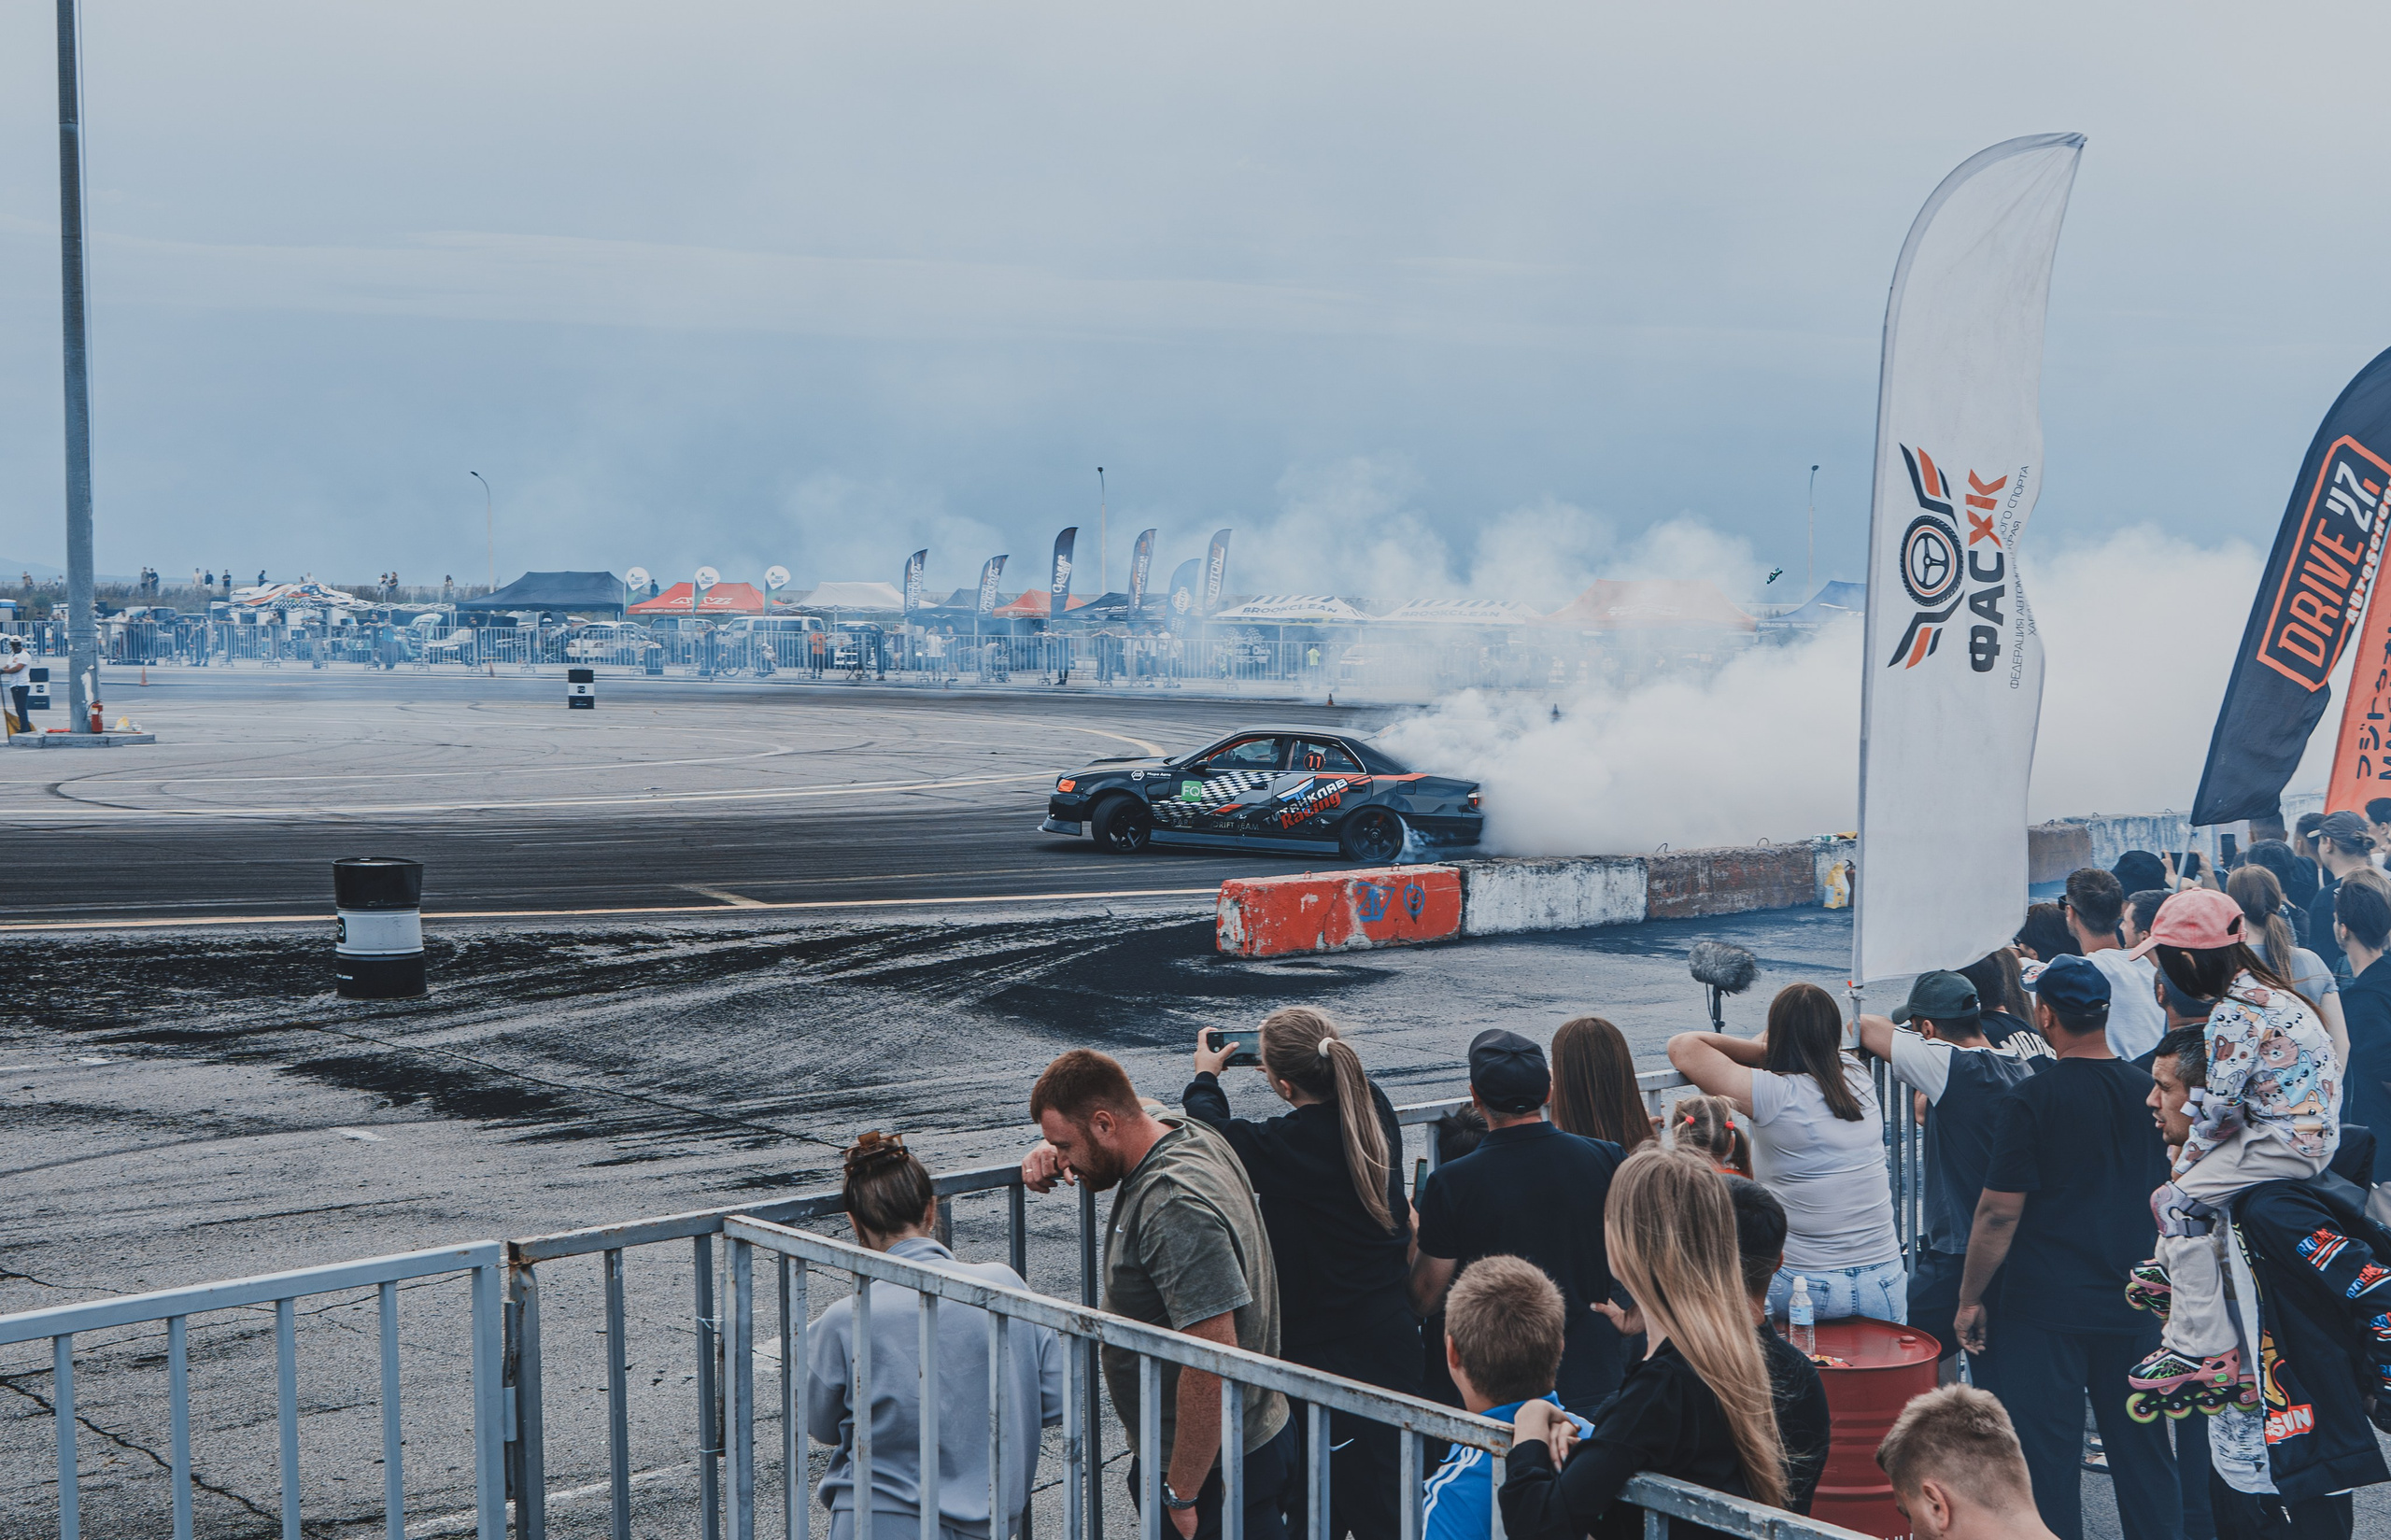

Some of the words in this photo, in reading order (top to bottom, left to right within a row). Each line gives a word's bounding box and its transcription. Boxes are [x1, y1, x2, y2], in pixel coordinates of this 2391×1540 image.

[2007, 465, 2030, 509] СПОРТА
[2344, 476, 2391, 626] AUTOSCHOO
[1242, 603, 1337, 614] BROOKCLEAN
[2278, 517, 2365, 669] DRIVE
[2010, 619, 2025, 689] ФЕДЕРАЦИЯ
[1309, 755, 1322, 769] 11
[1182, 785, 1201, 797] FQ
[1280, 790, 1342, 830] Racing
[1211, 820, 1235, 829] DRIFT
